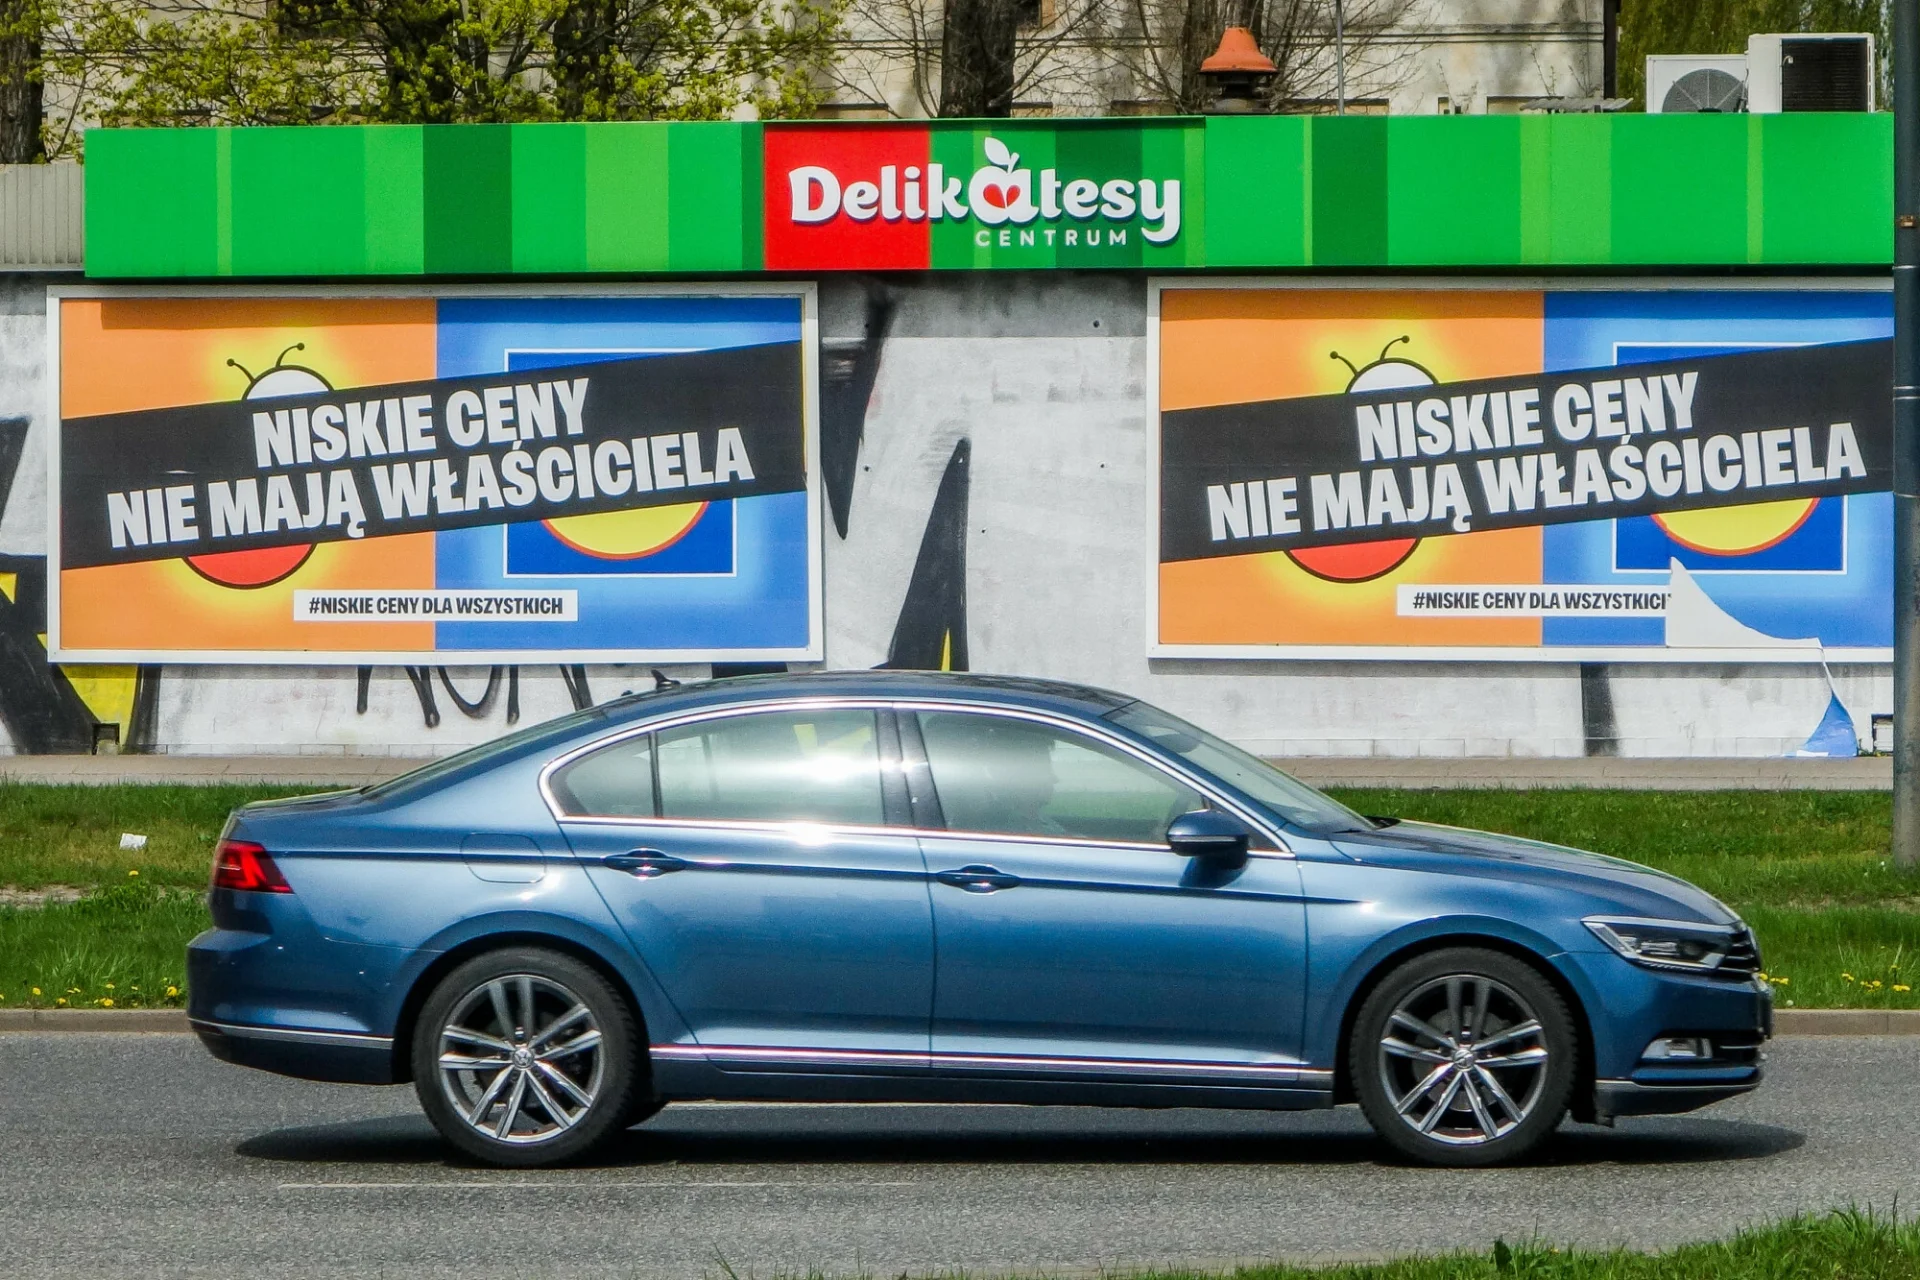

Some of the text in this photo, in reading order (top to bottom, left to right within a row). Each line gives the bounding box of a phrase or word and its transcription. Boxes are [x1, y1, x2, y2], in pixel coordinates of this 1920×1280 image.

[788, 162, 1181, 243] Delikatesy
[975, 229, 1127, 247] CENTRUM
[252, 378, 591, 468] NISKIE CENY
[1356, 372, 1699, 462] NISKIE CENY
[107, 427, 755, 549] NIE MAJĄ WŁAŚCICIELA
[1206, 422, 1868, 541] NIE MAJĄ WŁAŚCICIELA
[308, 597, 564, 615] #NISKIE CENY DLA WSZYSTKICH
[1413, 592, 1480, 609] #NISKIE
[1482, 592, 1526, 609] CENY
[1529, 592, 1561, 610] DLA
